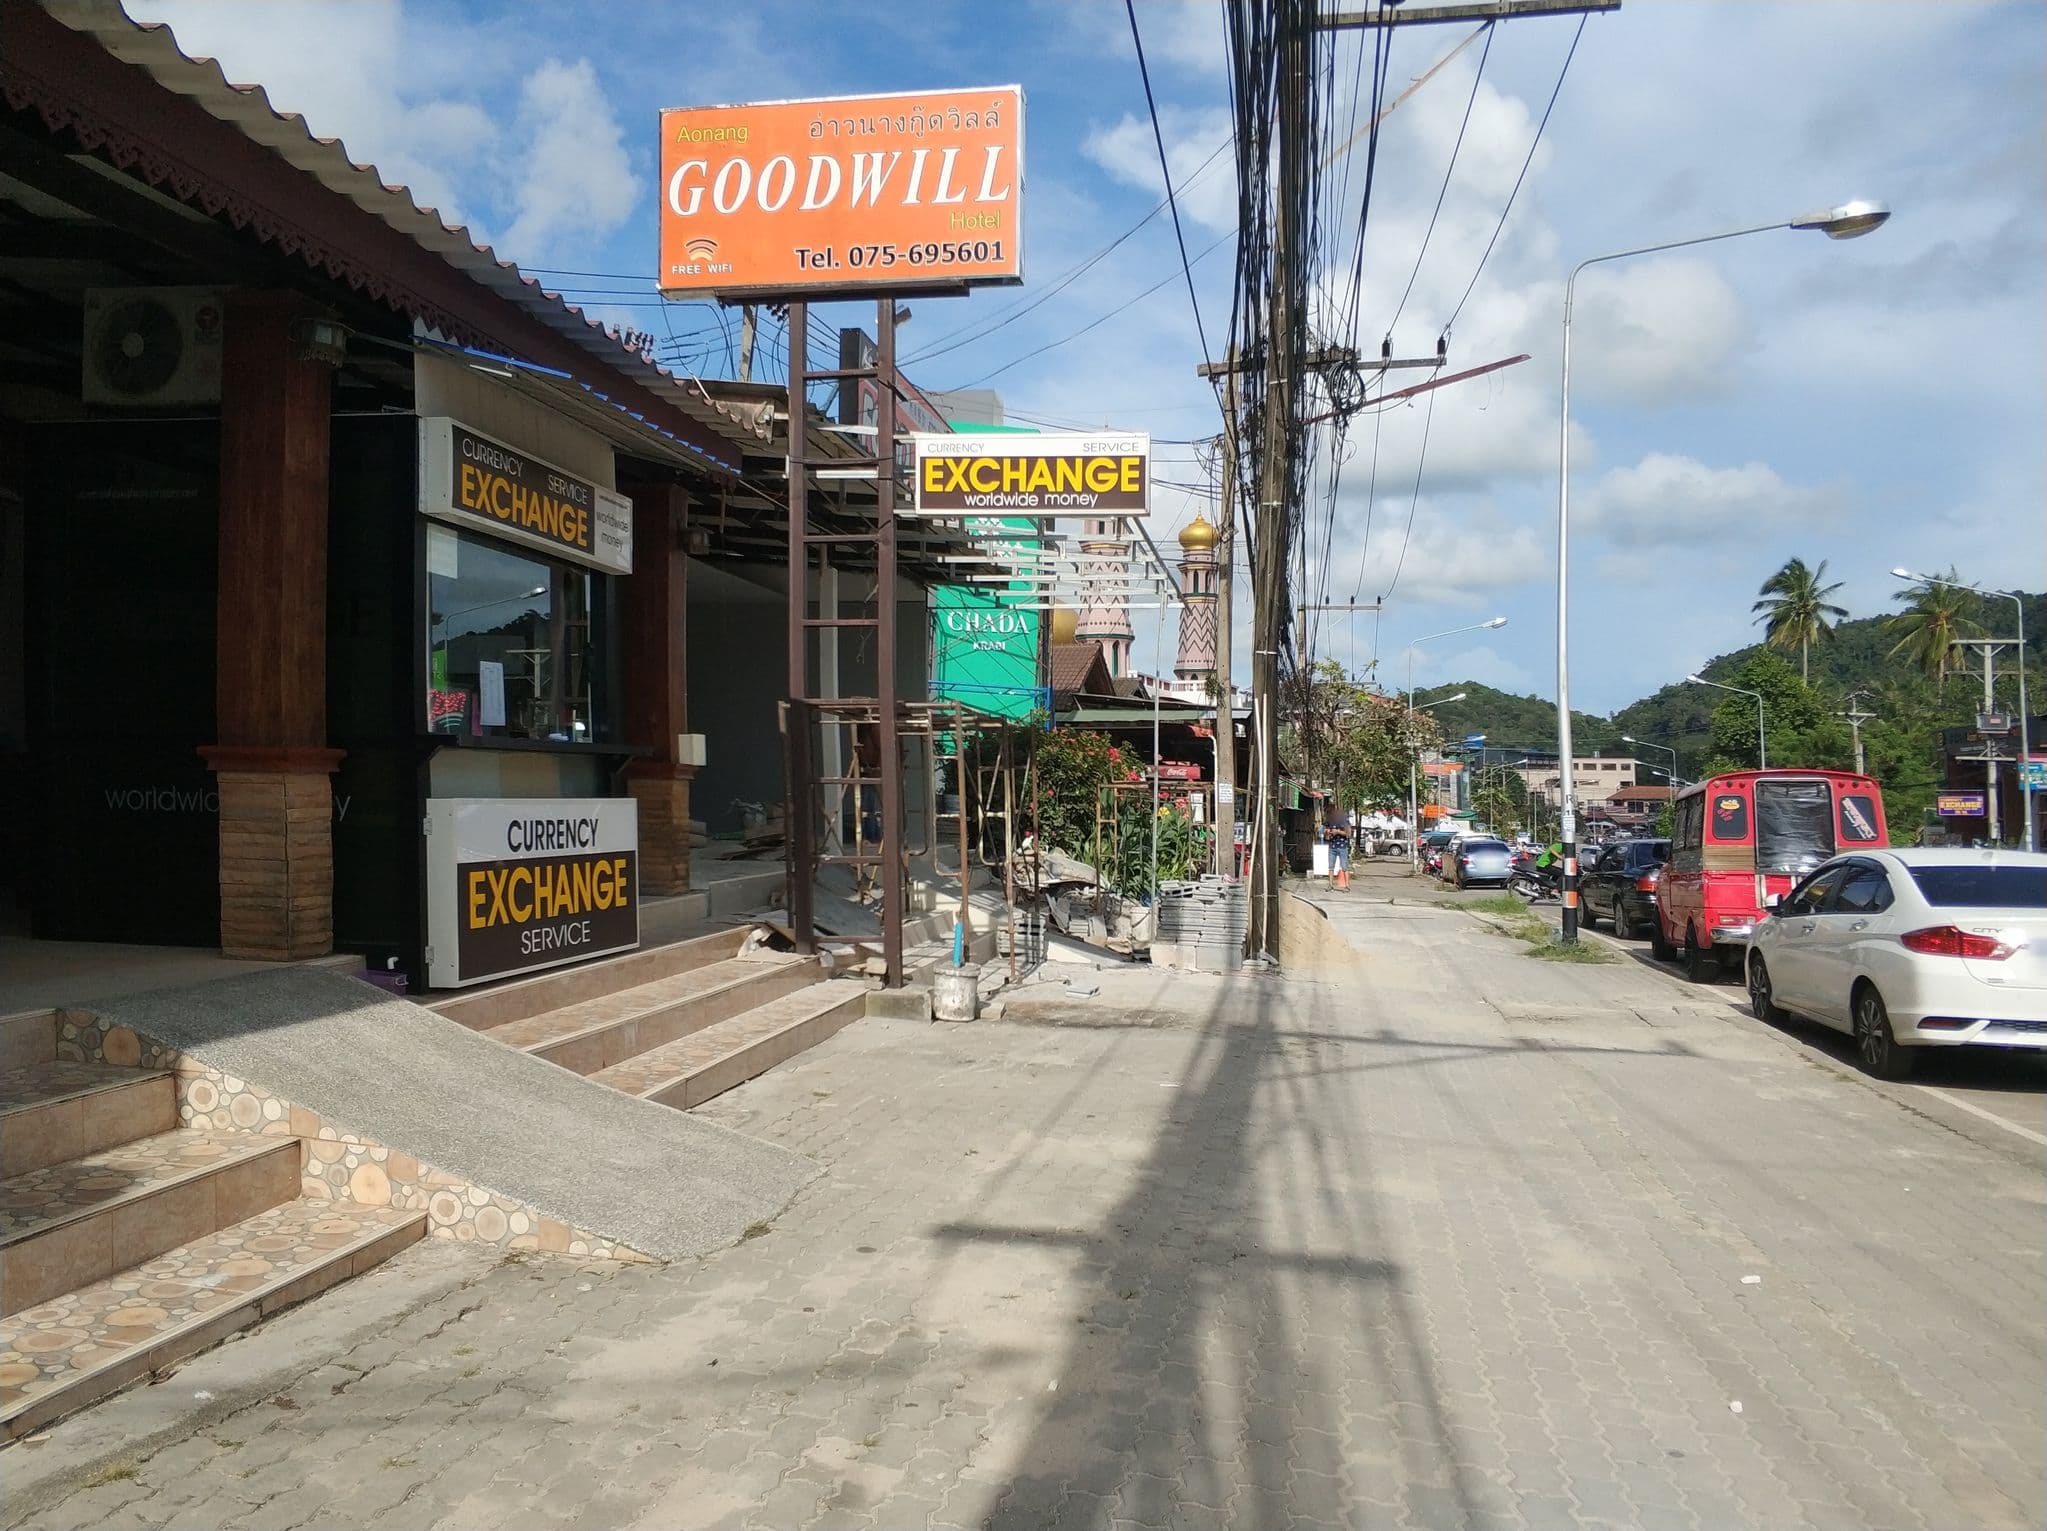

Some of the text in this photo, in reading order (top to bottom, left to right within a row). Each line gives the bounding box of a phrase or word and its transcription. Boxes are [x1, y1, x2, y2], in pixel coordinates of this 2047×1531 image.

[677, 124, 748, 144] Aonang
[809, 101, 1003, 138] อ่าวนางกู๊ดวิลล์
[668, 145, 1011, 216] GOODWILL
[950, 211, 1001, 230] Hotel
[672, 262, 733, 275] FREE WIFI
[796, 241, 1005, 271] Tel. 075-695601
[927, 441, 1139, 453] CURRENCY SERVICE
[462, 438, 588, 505] CURRENCY SERVICE
[924, 457, 1140, 493] EXCHANGE
[462, 463, 588, 547] EXCHANGE
[964, 492, 1099, 508] worldwide money
[601, 531, 624, 552] money
[947, 611, 1030, 634] CHADA
[507, 818, 599, 852] CURRENCY
[469, 859, 628, 930] EXCHANGE
[521, 921, 591, 954] SERVICE
